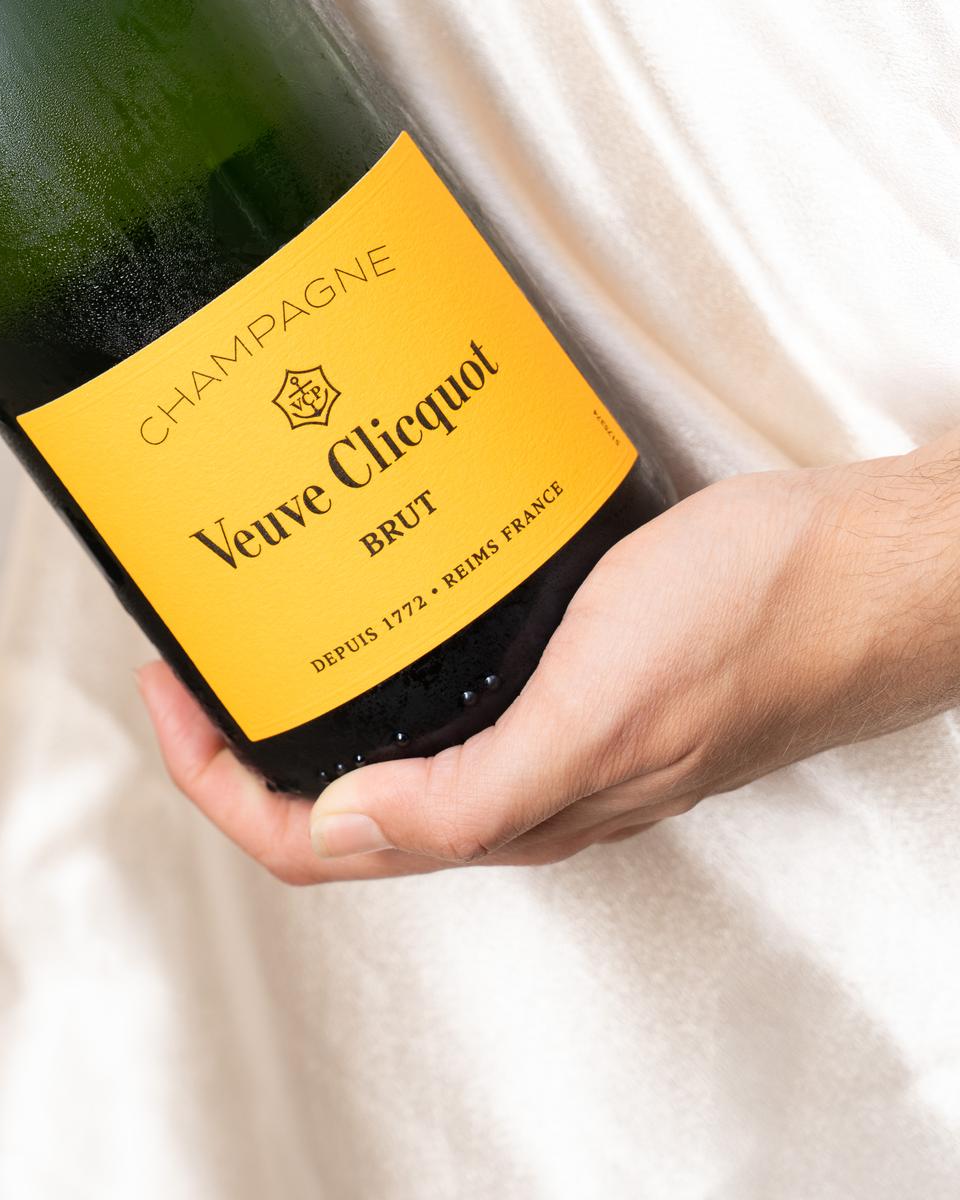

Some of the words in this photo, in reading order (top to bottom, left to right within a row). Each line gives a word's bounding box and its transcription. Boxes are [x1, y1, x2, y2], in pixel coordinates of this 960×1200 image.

[140, 244, 396, 446] CHAMPAGNE
[289, 385, 321, 411] VCP
[189, 486, 332, 570] Veuve
[327, 339, 499, 489] Clicquot
[359, 490, 438, 558] BRUT
[310, 627, 378, 673] DEPUIS
[382, 596, 428, 631] 1772
[441, 539, 500, 589] REIMS
[500, 480, 564, 543] FRANCE
